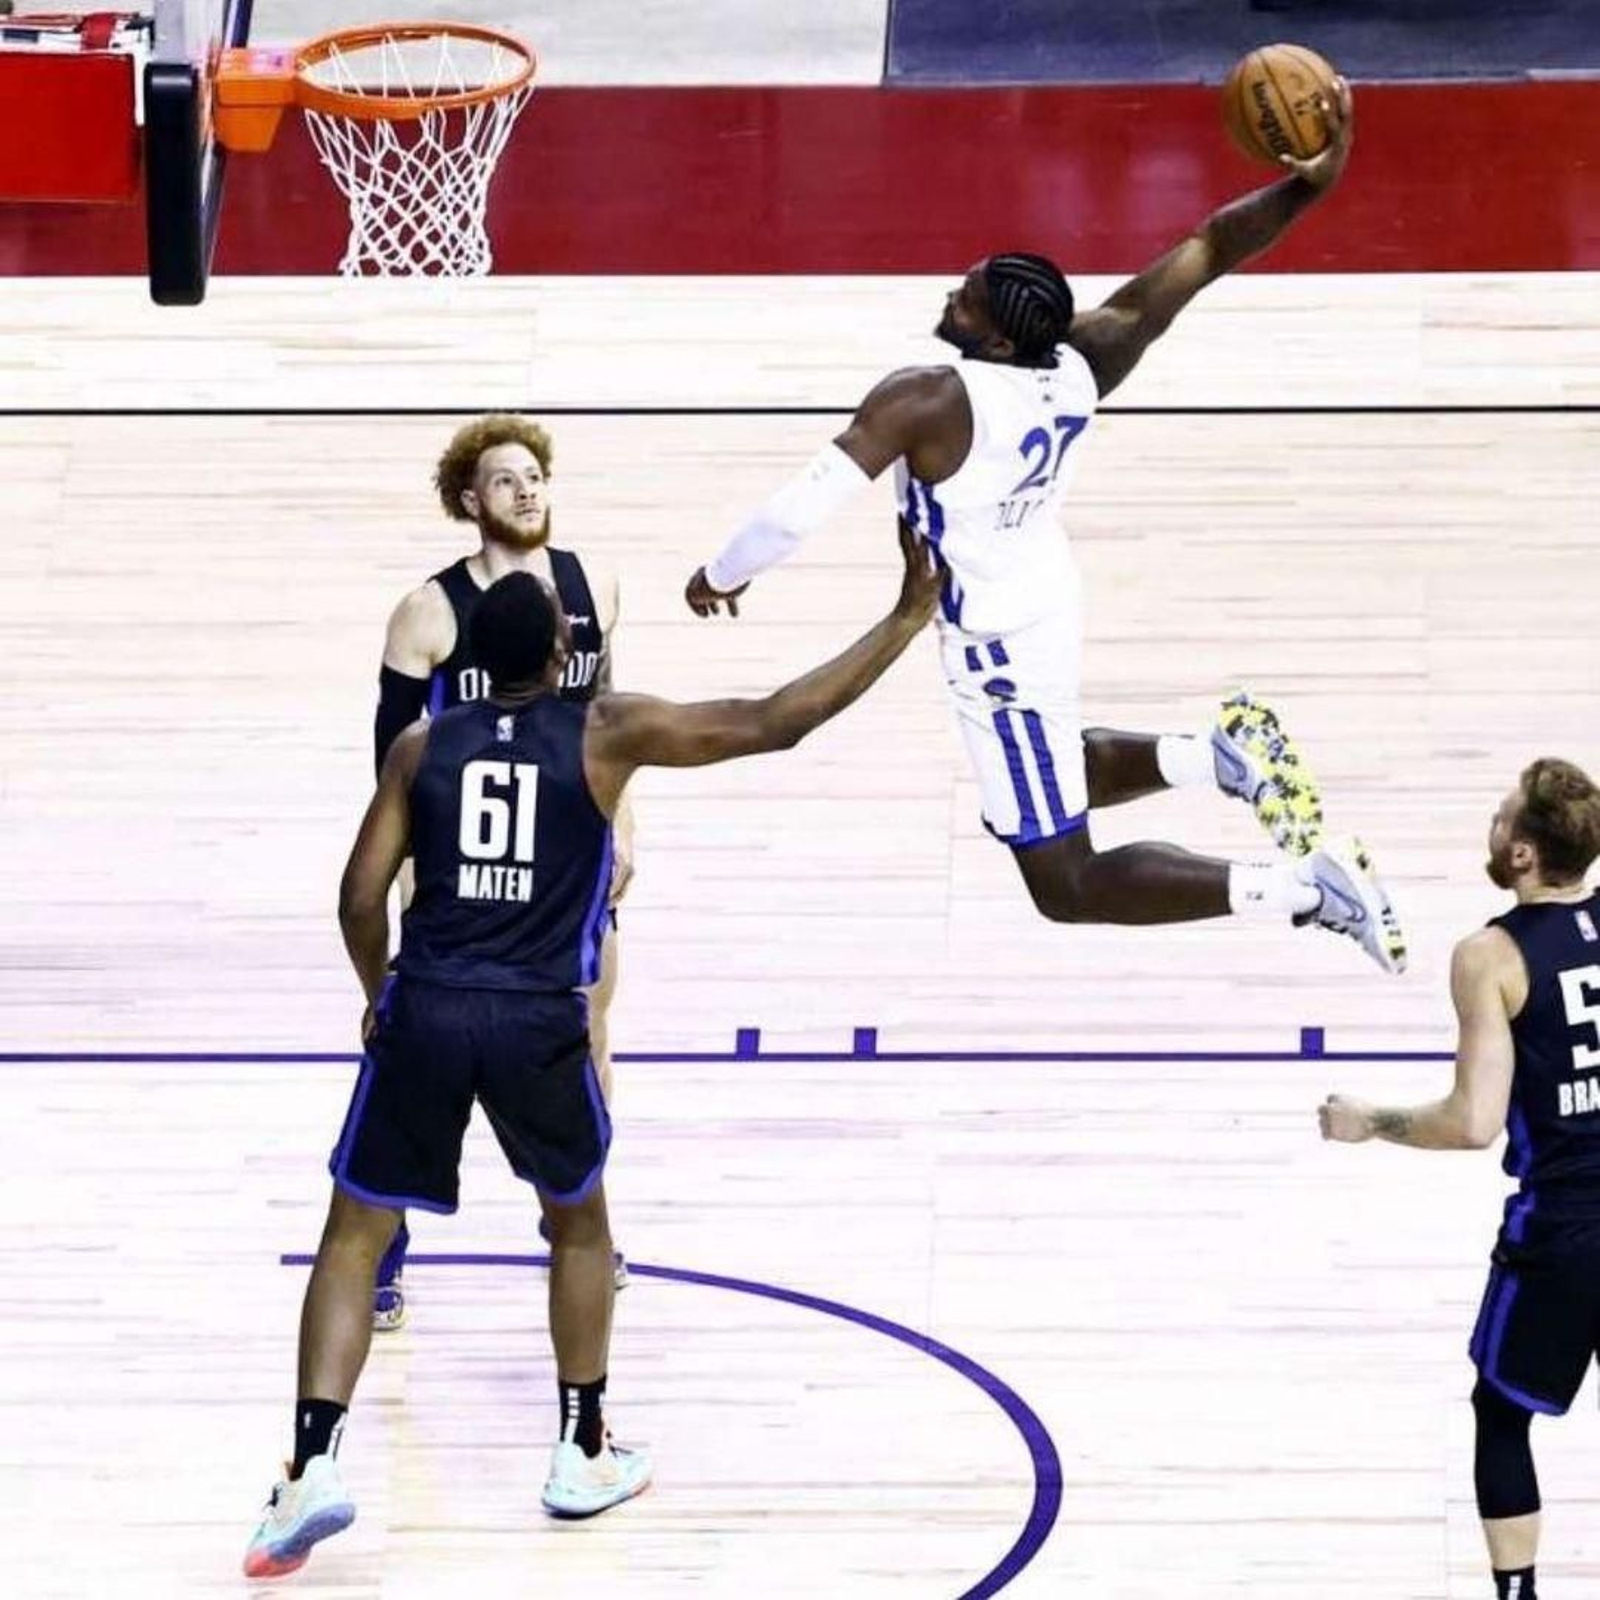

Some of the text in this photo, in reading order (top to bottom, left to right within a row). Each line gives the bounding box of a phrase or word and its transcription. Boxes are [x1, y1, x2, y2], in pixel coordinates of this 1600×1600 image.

[1010, 415, 1089, 495] 27
[459, 760, 539, 862] 61
[457, 864, 533, 903] MATEN
